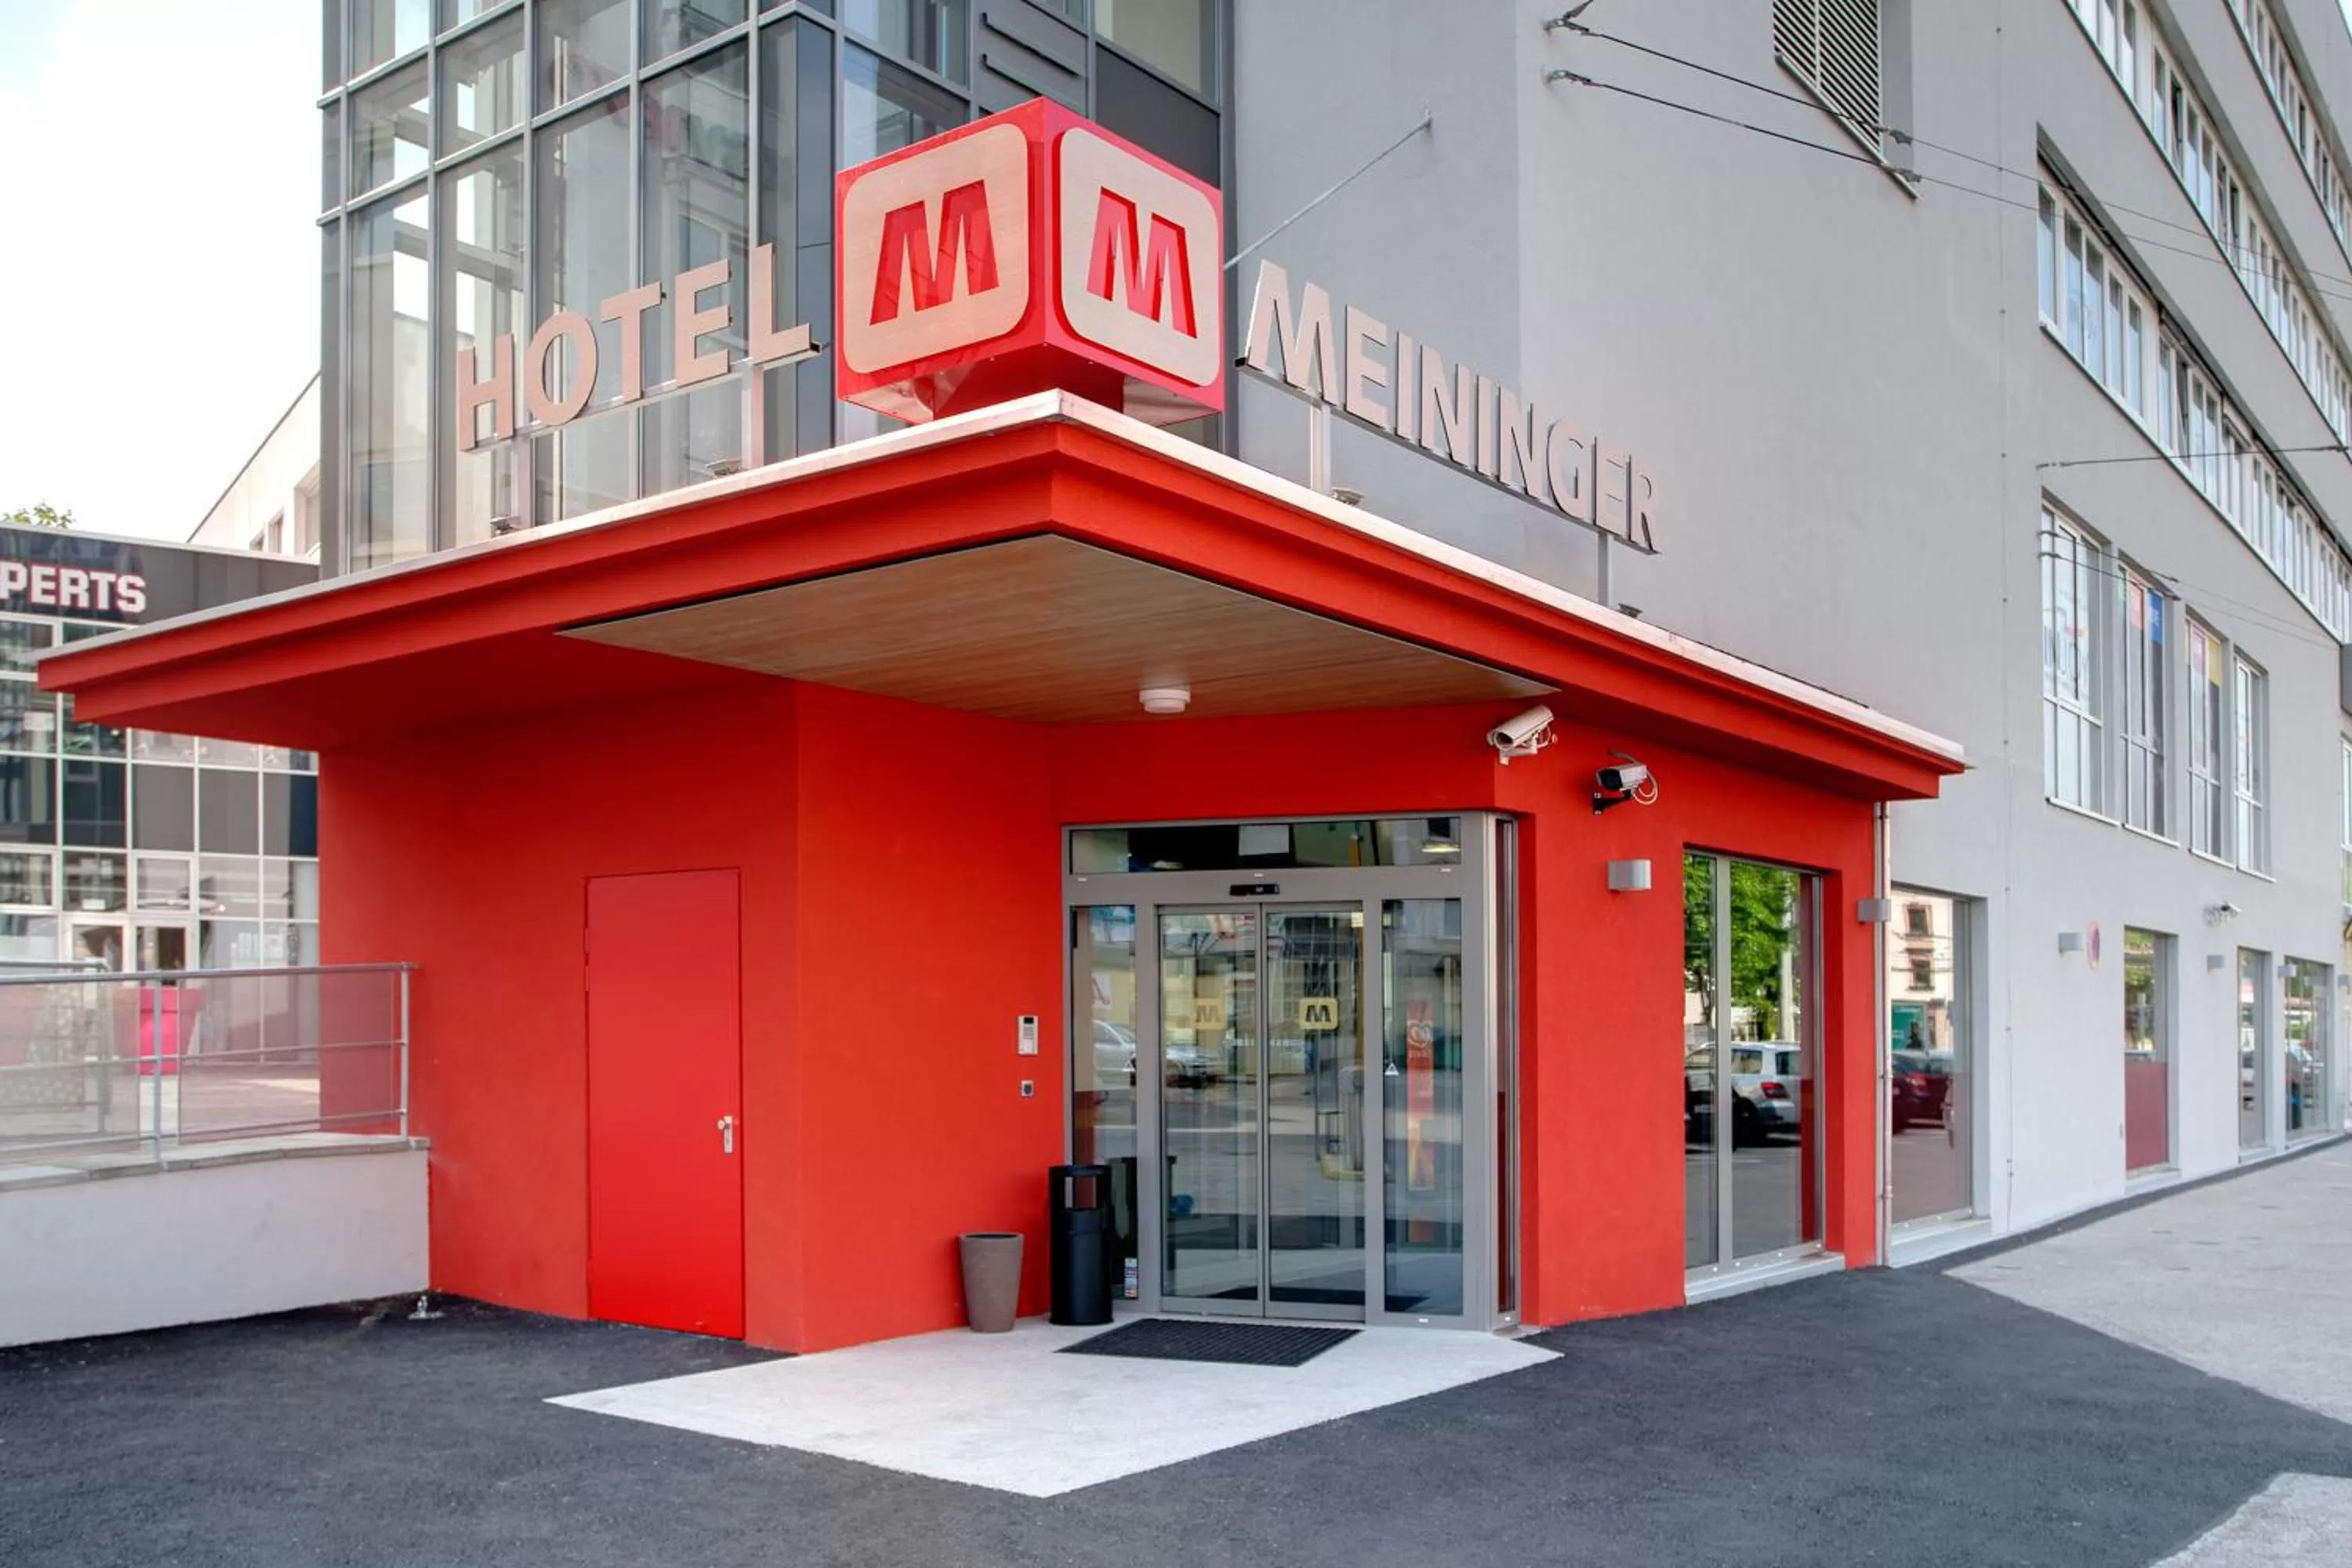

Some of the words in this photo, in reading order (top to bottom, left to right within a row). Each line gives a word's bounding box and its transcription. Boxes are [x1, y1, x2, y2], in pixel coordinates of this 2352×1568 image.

[869, 179, 1000, 326] M
[1086, 185, 1198, 339] M
[458, 242, 810, 452] HOTEL
[1245, 259, 1658, 554] MEININGER
[0, 559, 147, 613] PERTS
[1305, 1004, 1331, 1022] M
